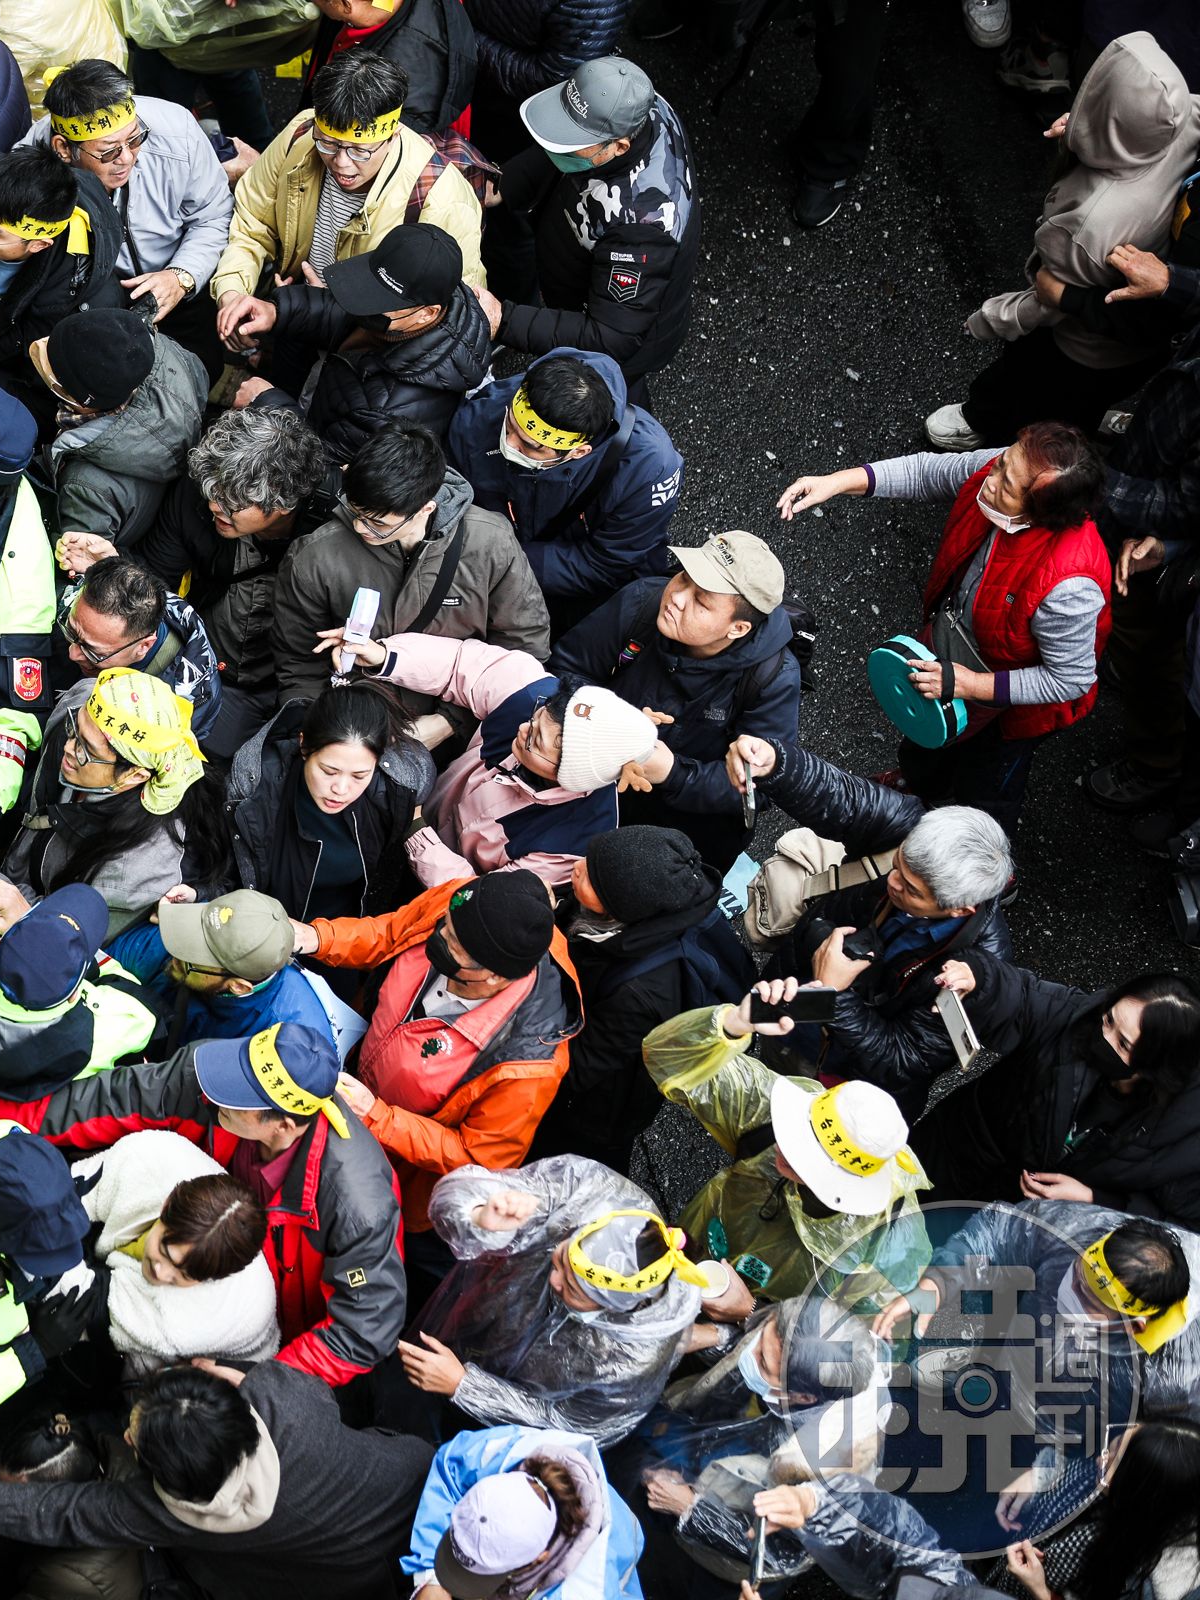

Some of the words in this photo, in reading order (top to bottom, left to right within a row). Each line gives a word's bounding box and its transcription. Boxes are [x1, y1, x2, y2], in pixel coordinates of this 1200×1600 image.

[89, 693, 147, 743] 台灣不會好
